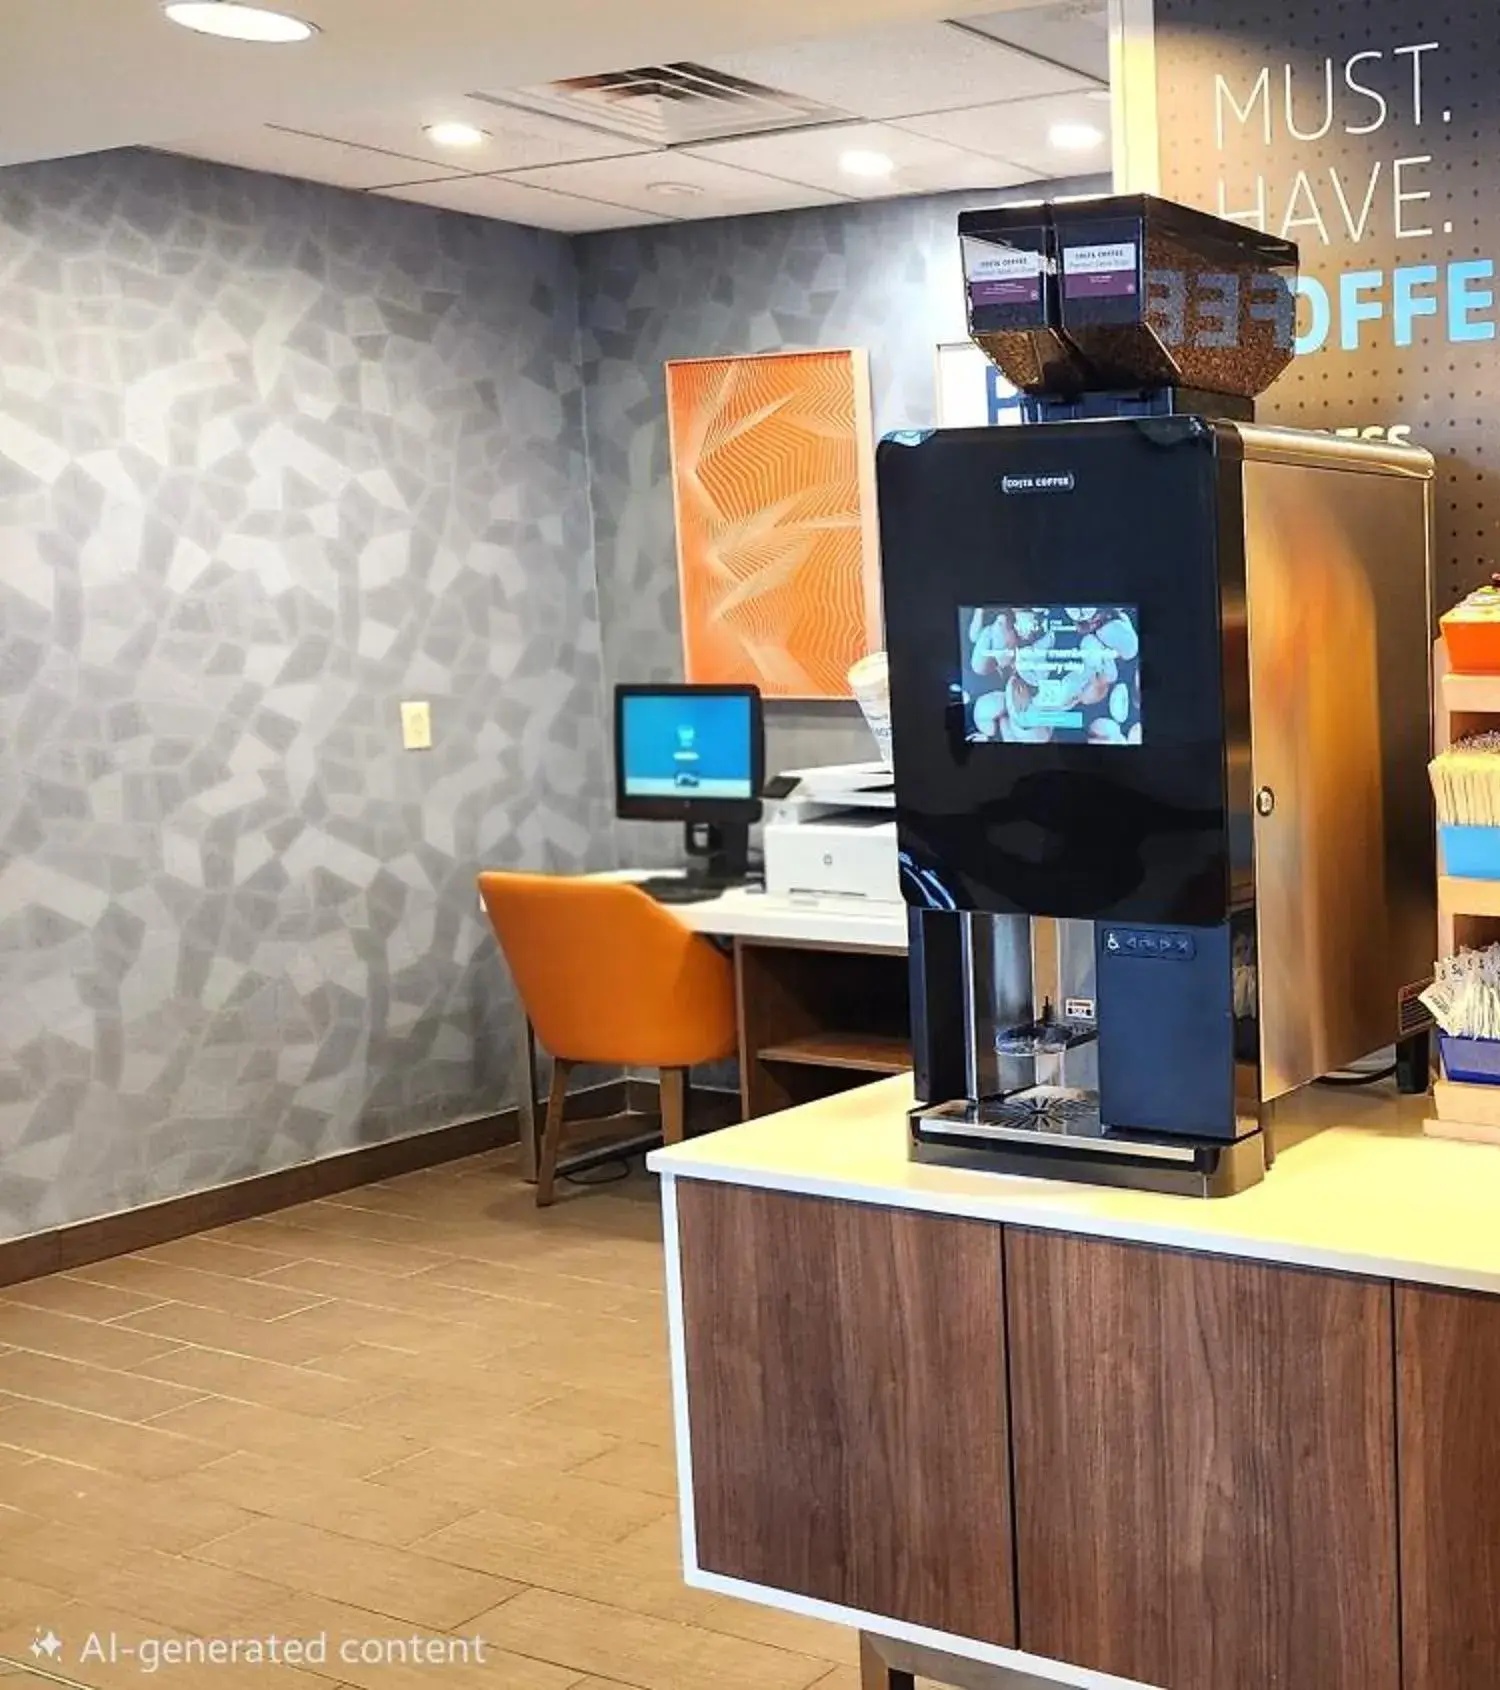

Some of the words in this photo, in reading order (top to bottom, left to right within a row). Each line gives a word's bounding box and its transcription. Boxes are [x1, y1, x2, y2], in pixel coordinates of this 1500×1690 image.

[1215, 42, 1451, 150] MUST.
[1218, 155, 1452, 245] HAVE.
[1006, 478, 1034, 489] COSTA
[1035, 476, 1069, 487] COFFEE
